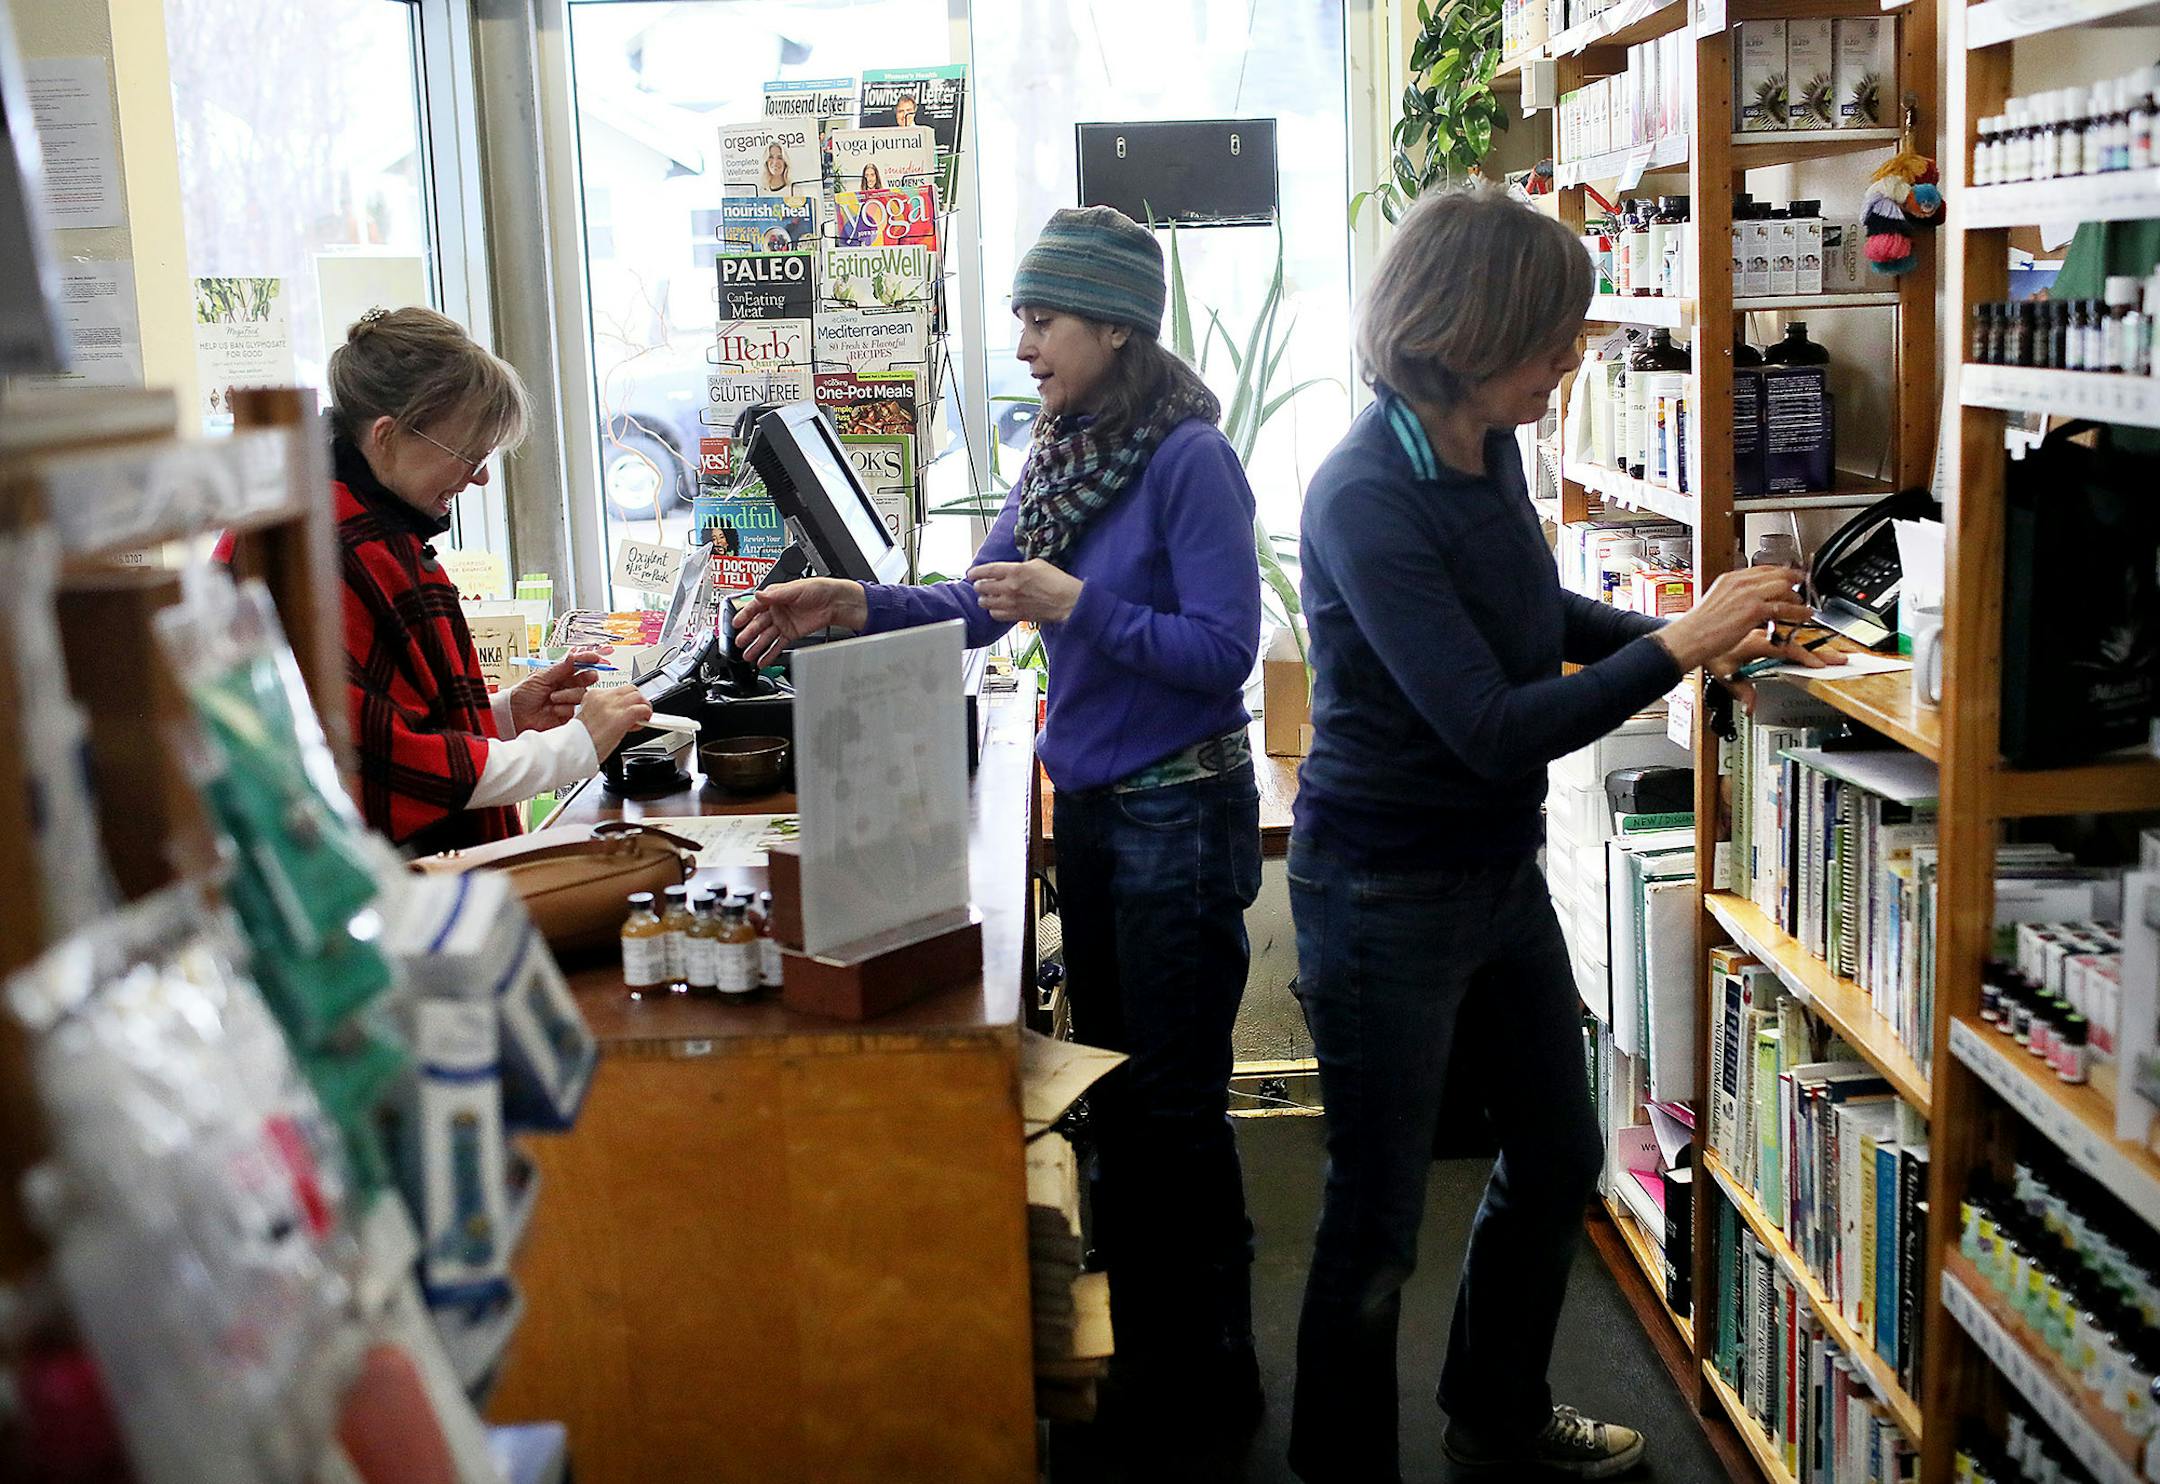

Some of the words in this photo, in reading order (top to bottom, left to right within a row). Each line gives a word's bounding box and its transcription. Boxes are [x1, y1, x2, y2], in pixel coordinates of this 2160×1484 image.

[765, 93, 815, 115] Townsend
[817, 93, 847, 113] Letter
[724, 132, 774, 152] organic
[778, 132, 805, 148] spa
[835, 140, 867, 156] yoga
[869, 134, 922, 154] journal
[726, 158, 759, 168] Complete
[726, 167, 759, 177] Wellness
[887, 178, 925, 188] WOMEN'S
[840, 196, 930, 244] yoga
[727, 292, 744, 303] Can
[744, 292, 785, 309] Eating
[731, 304, 764, 318] Meat
[818, 322, 913, 340] Mediterranean
[199, 342, 217, 350] HELP
[245, 340, 287, 349] GLYPHOSATE
[720, 330, 800, 361] Herb
[829, 342, 839, 351] 80
[840, 340, 860, 350] Fresh
[871, 338, 906, 350] Flavorful
[242, 350, 263, 358] GOOD
[849, 349, 892, 360] RECIPES
[708, 377, 732, 386] SIMPLY
[710, 385, 764, 402] GLUTEN
[768, 384, 800, 400] FREE
[815, 385, 872, 400] One-Pot
[874, 383, 914, 399] Meals
[700, 445, 729, 475] yes!
[700, 505, 778, 530] mindful
[765, 535, 781, 543] Your
[743, 543, 782, 554] Anxious
[628, 546, 669, 570] Oxylent
[723, 559, 773, 574] DOCTORS
[641, 571, 651, 580] per
[651, 569, 669, 584] Pack
[723, 572, 749, 585] TELL
[1633, 818, 1655, 826] NEW
[1713, 1021, 1723, 1088] NUTRITIONAL
[1906, 1161, 1919, 1224] Chinese
[1904, 1230, 1916, 1294] Natural
[1902, 1298, 1913, 1345] Cures
